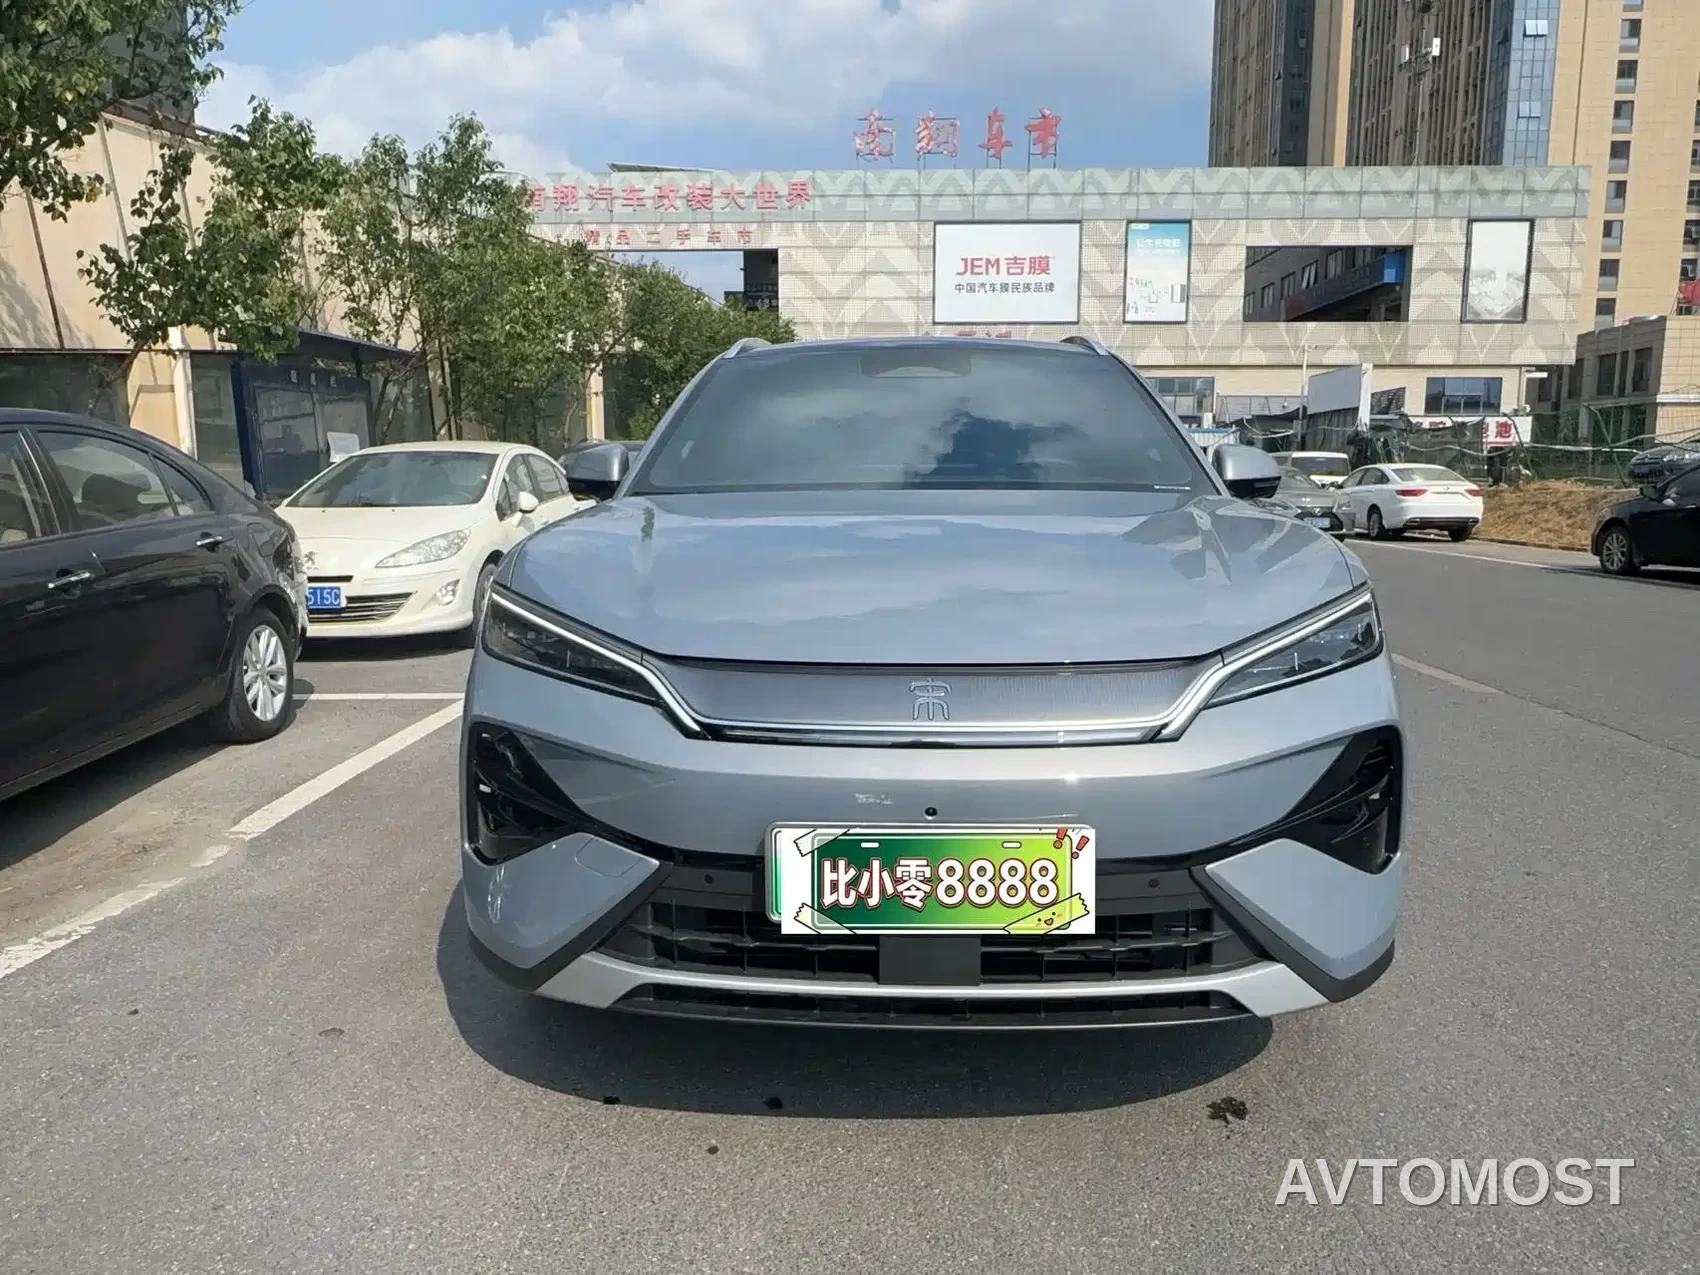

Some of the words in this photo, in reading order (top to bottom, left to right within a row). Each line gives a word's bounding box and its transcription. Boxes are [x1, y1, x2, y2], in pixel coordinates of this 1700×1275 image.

[956, 257, 1000, 276] JEM
[1004, 255, 1051, 276] 吉膜
[955, 281, 1055, 294] 中国汽车膜民族品牌
